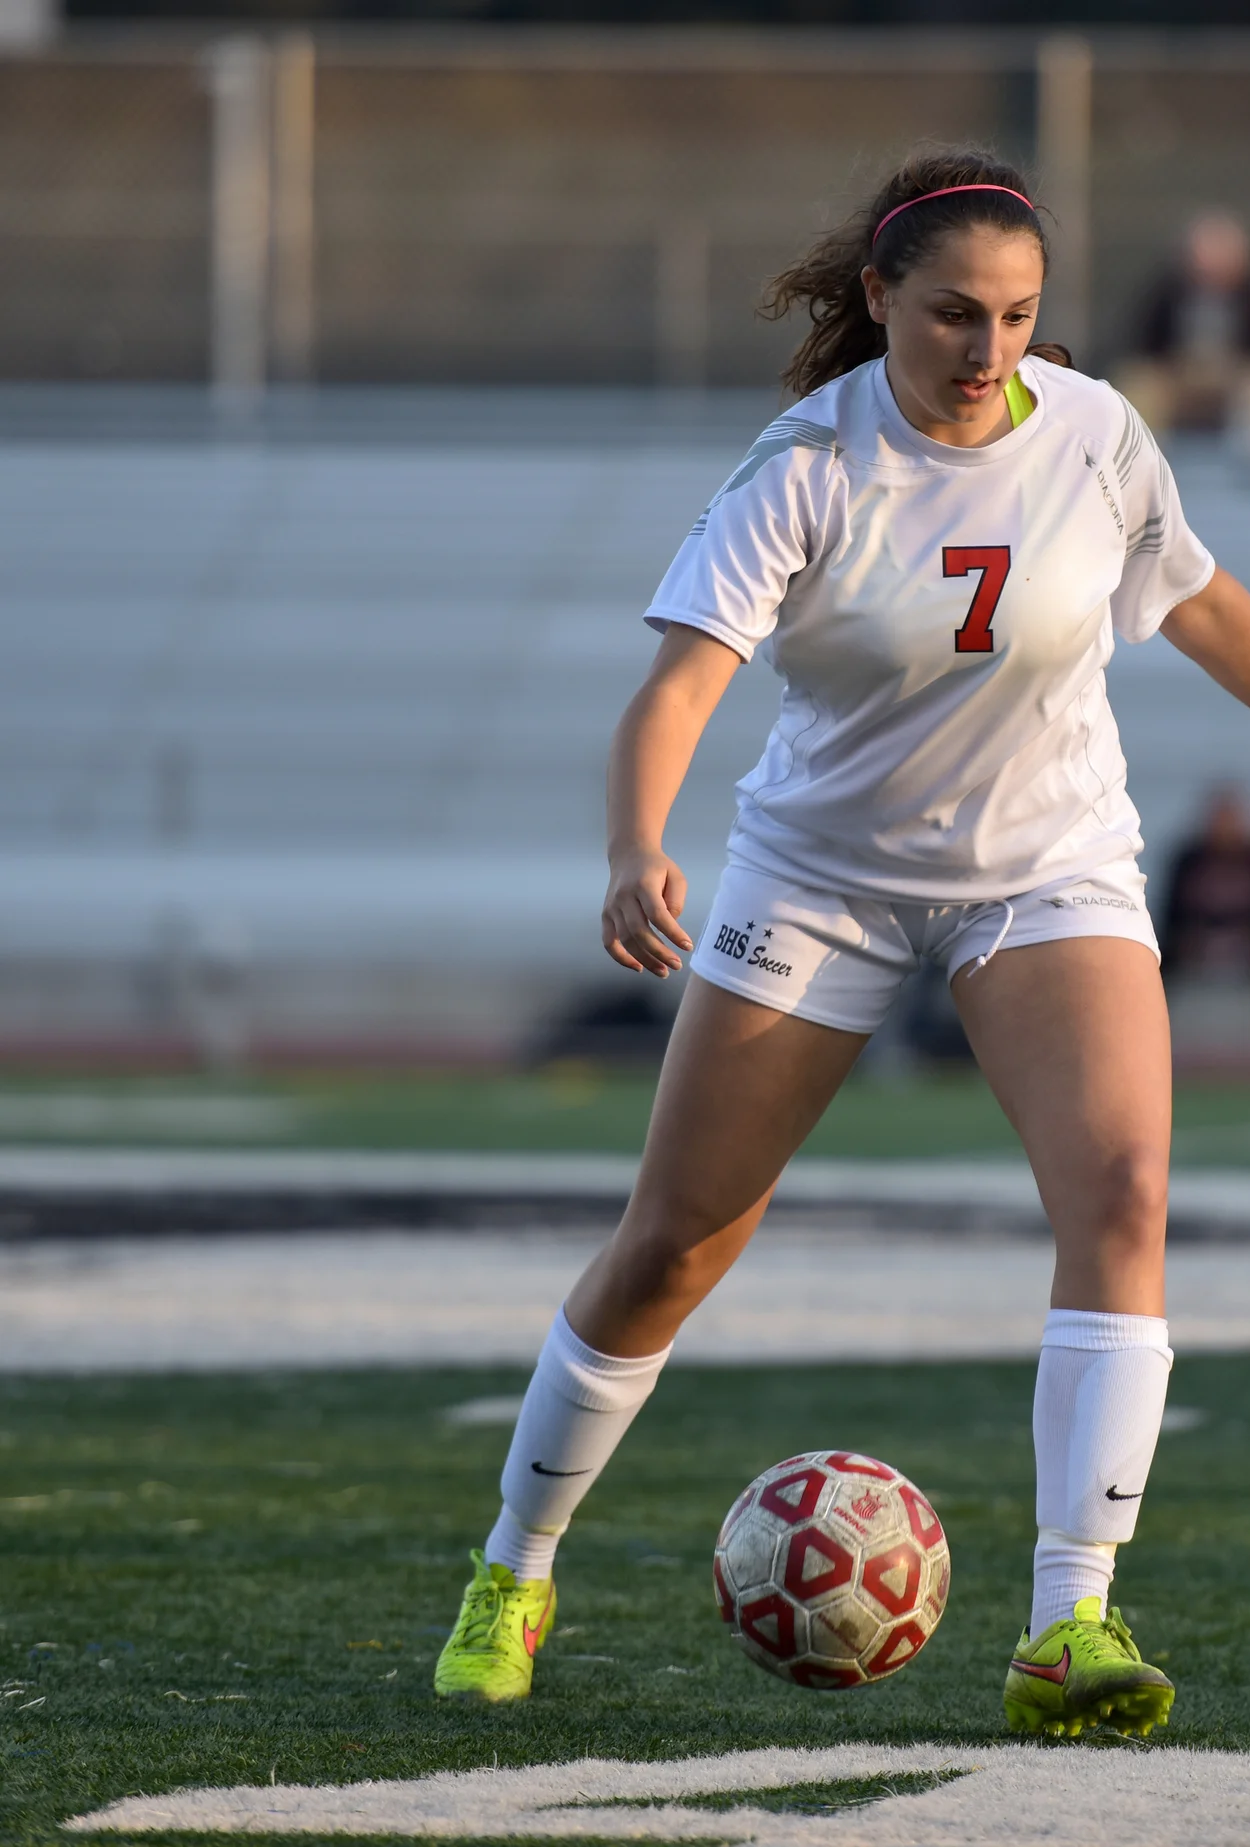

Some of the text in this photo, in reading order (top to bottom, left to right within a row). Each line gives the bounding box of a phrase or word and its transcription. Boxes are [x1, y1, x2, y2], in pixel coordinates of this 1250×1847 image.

[1097, 470, 1124, 535] DIADORA
[942, 545, 1011, 653] 7
[1072, 897, 1139, 911] DIADORA
[714, 924, 793, 977] BHS Soccer
